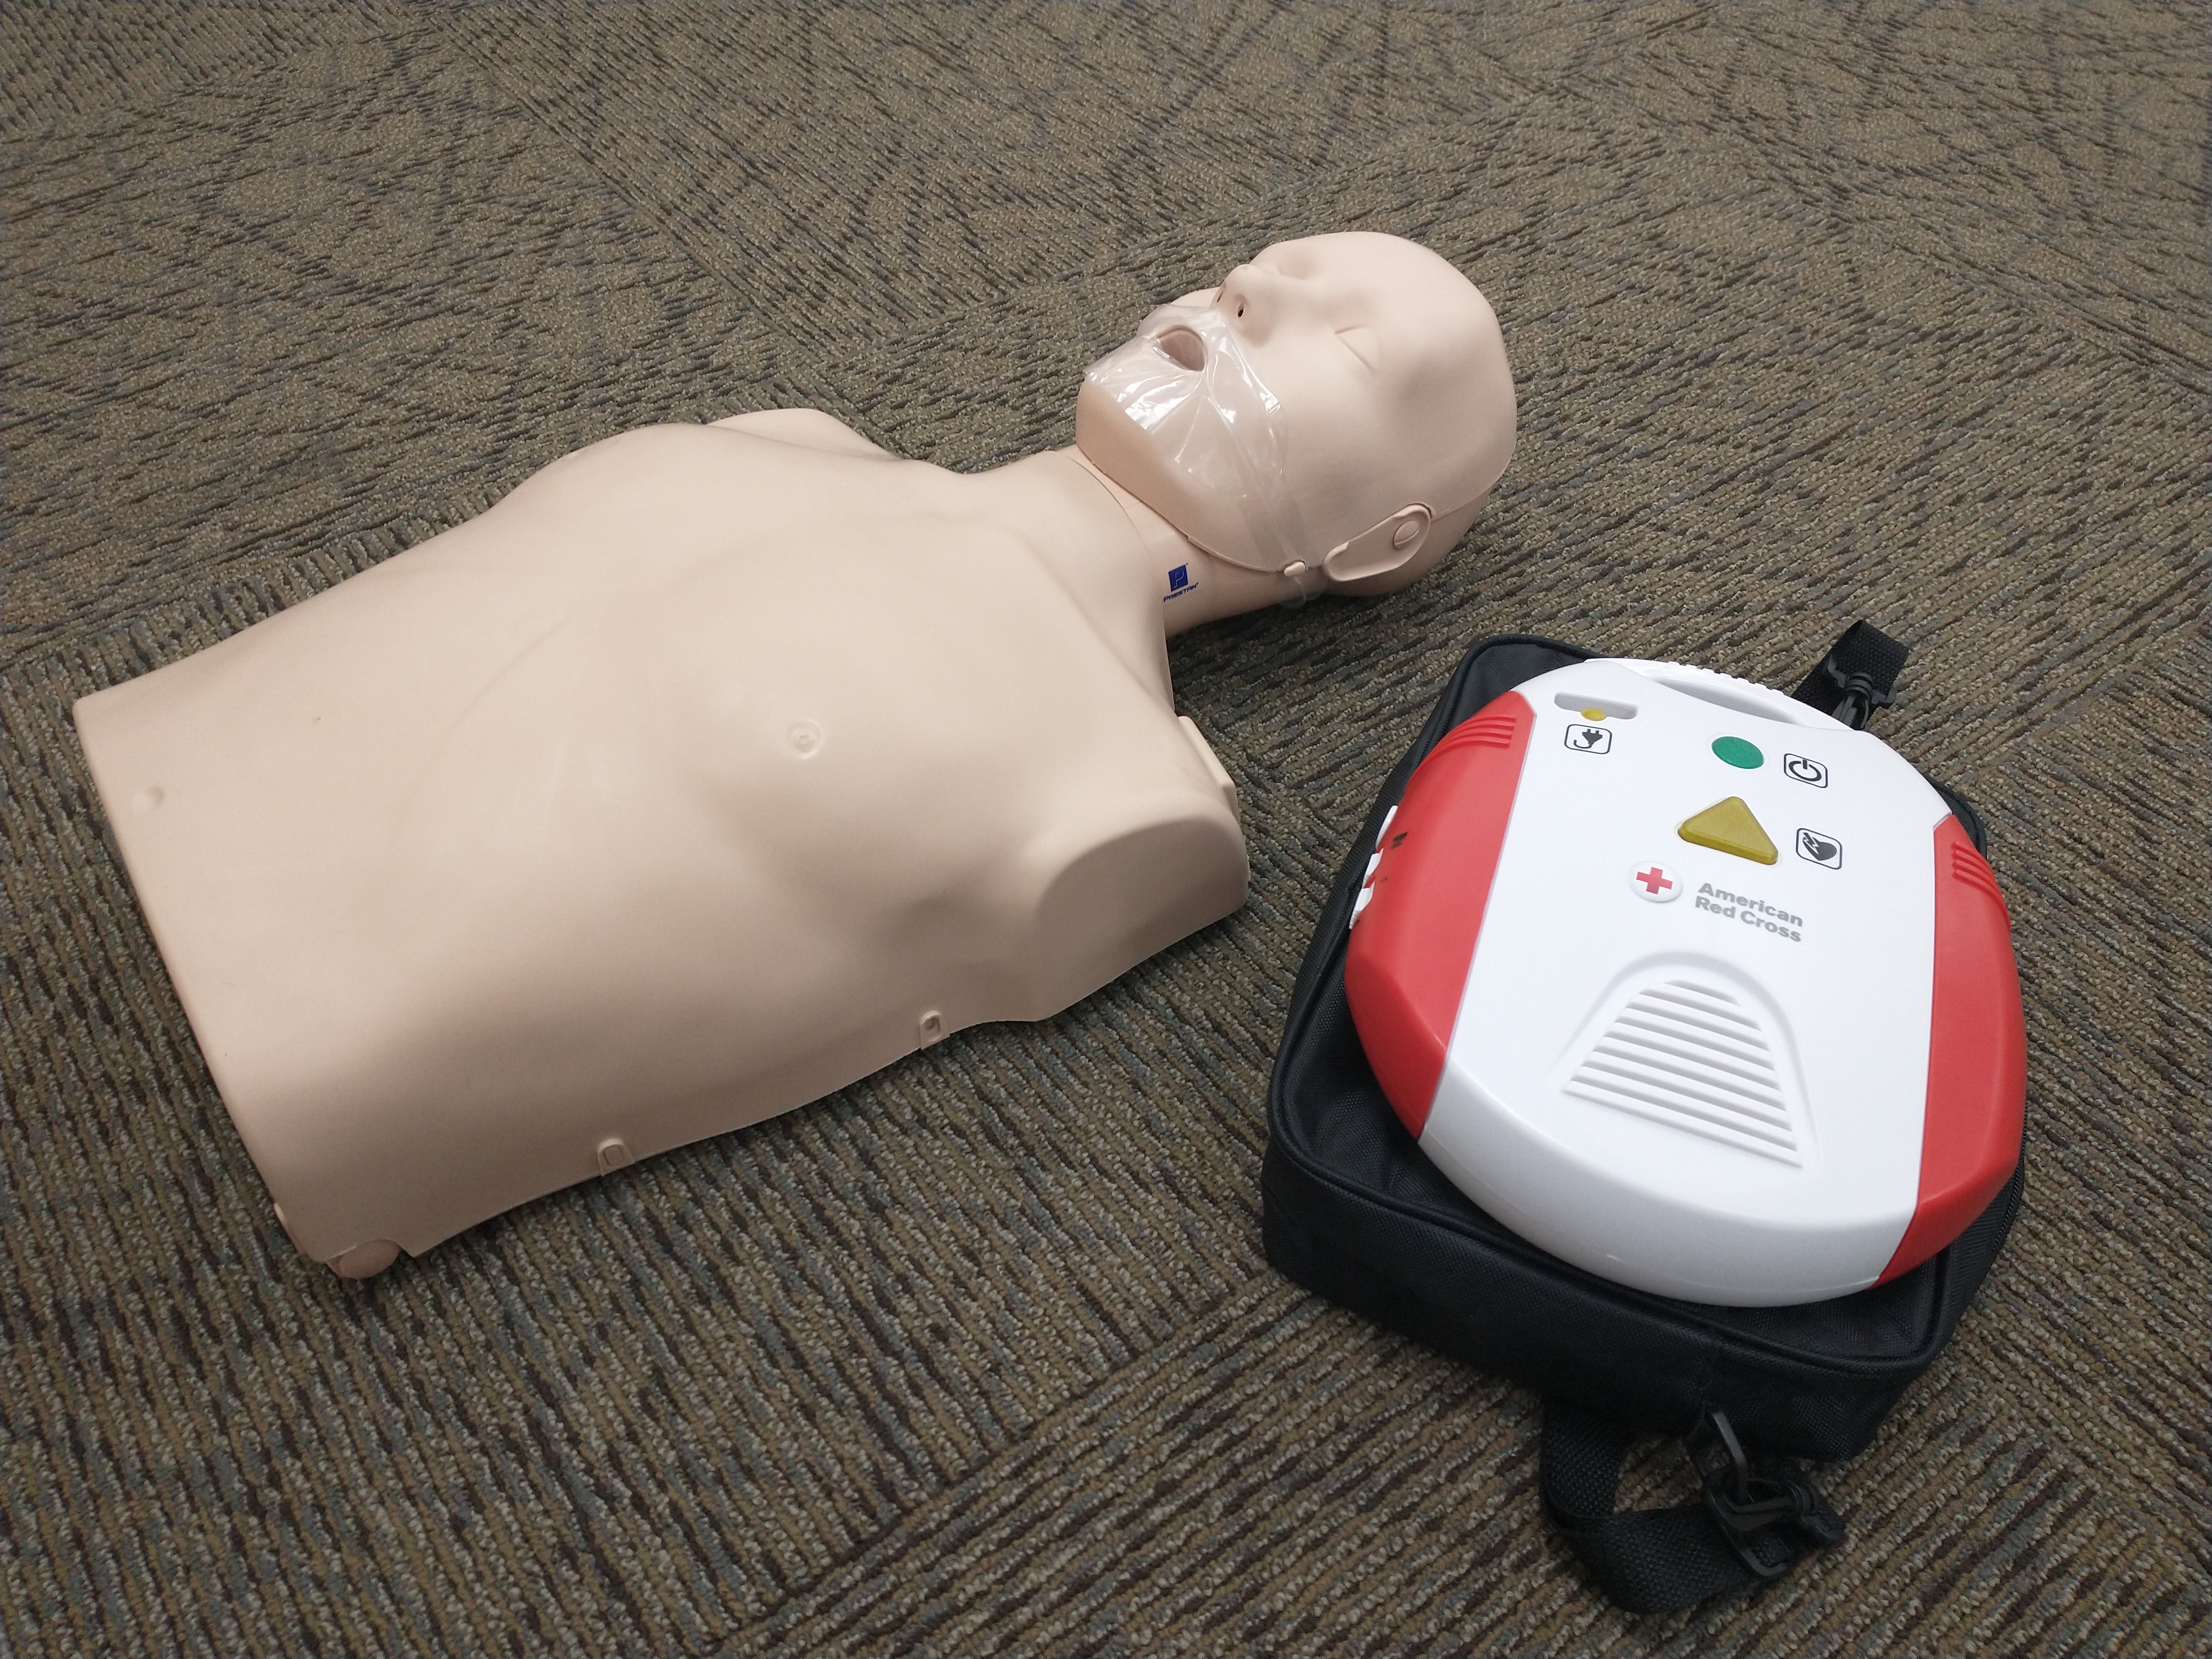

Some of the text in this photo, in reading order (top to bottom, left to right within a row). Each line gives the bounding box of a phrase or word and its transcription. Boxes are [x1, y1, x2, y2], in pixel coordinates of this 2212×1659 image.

[1695, 895, 1801, 942] Red Cross
[1698, 882, 1803, 927] American
